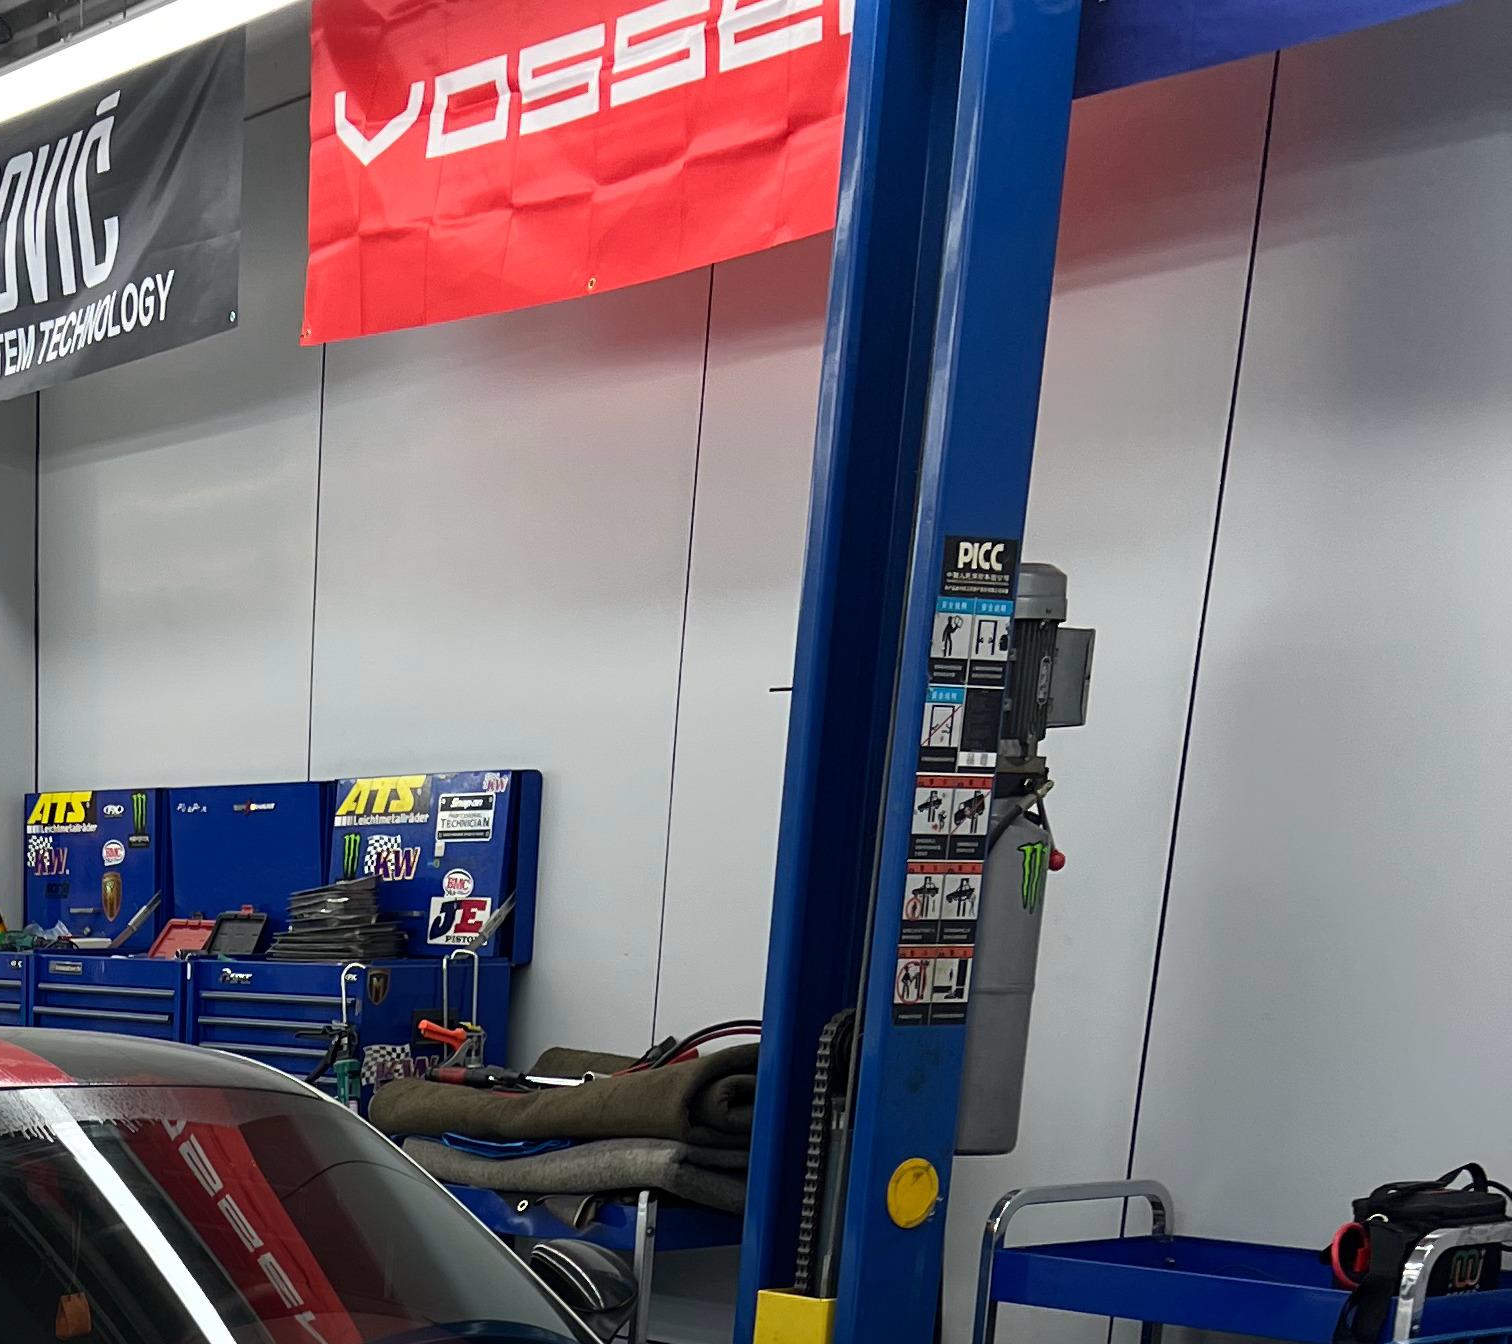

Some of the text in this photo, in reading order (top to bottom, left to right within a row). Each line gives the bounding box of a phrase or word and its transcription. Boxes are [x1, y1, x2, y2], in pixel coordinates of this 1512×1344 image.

[334, 0, 855, 167] VOSSE
[36, 268, 175, 368] TECHNOLOGY
[957, 541, 1005, 572] PICC
[27, 791, 93, 824] ATS
[336, 775, 426, 815] ATS
[354, 812, 430, 826] Leichtmetallräder
[441, 817, 491, 829] TECHNICIAN
[375, 846, 421, 881] KW
[429, 899, 488, 942] JE
[445, 934, 480, 944] PISTO
